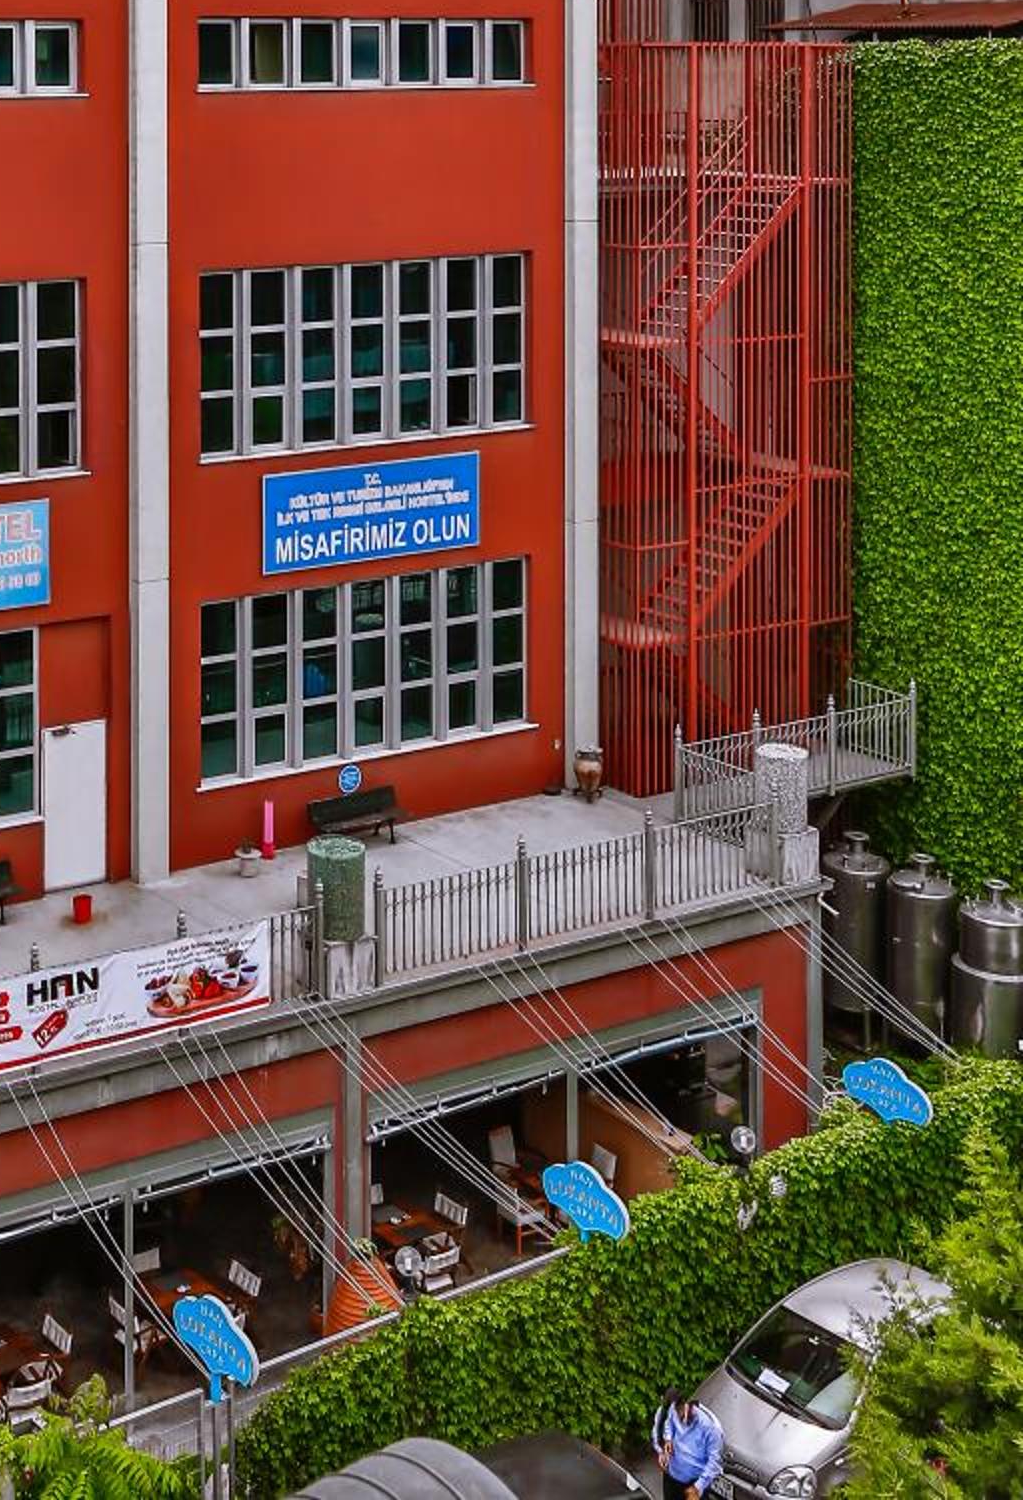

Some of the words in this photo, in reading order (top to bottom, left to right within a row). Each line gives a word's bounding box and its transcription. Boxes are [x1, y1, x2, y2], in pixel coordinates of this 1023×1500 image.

[289, 491, 329, 510] KÜLTÜR
[276, 517, 407, 565] MİSAFİRİMİZ
[412, 513, 471, 545] OLUN
[27, 967, 100, 1006] HAN
